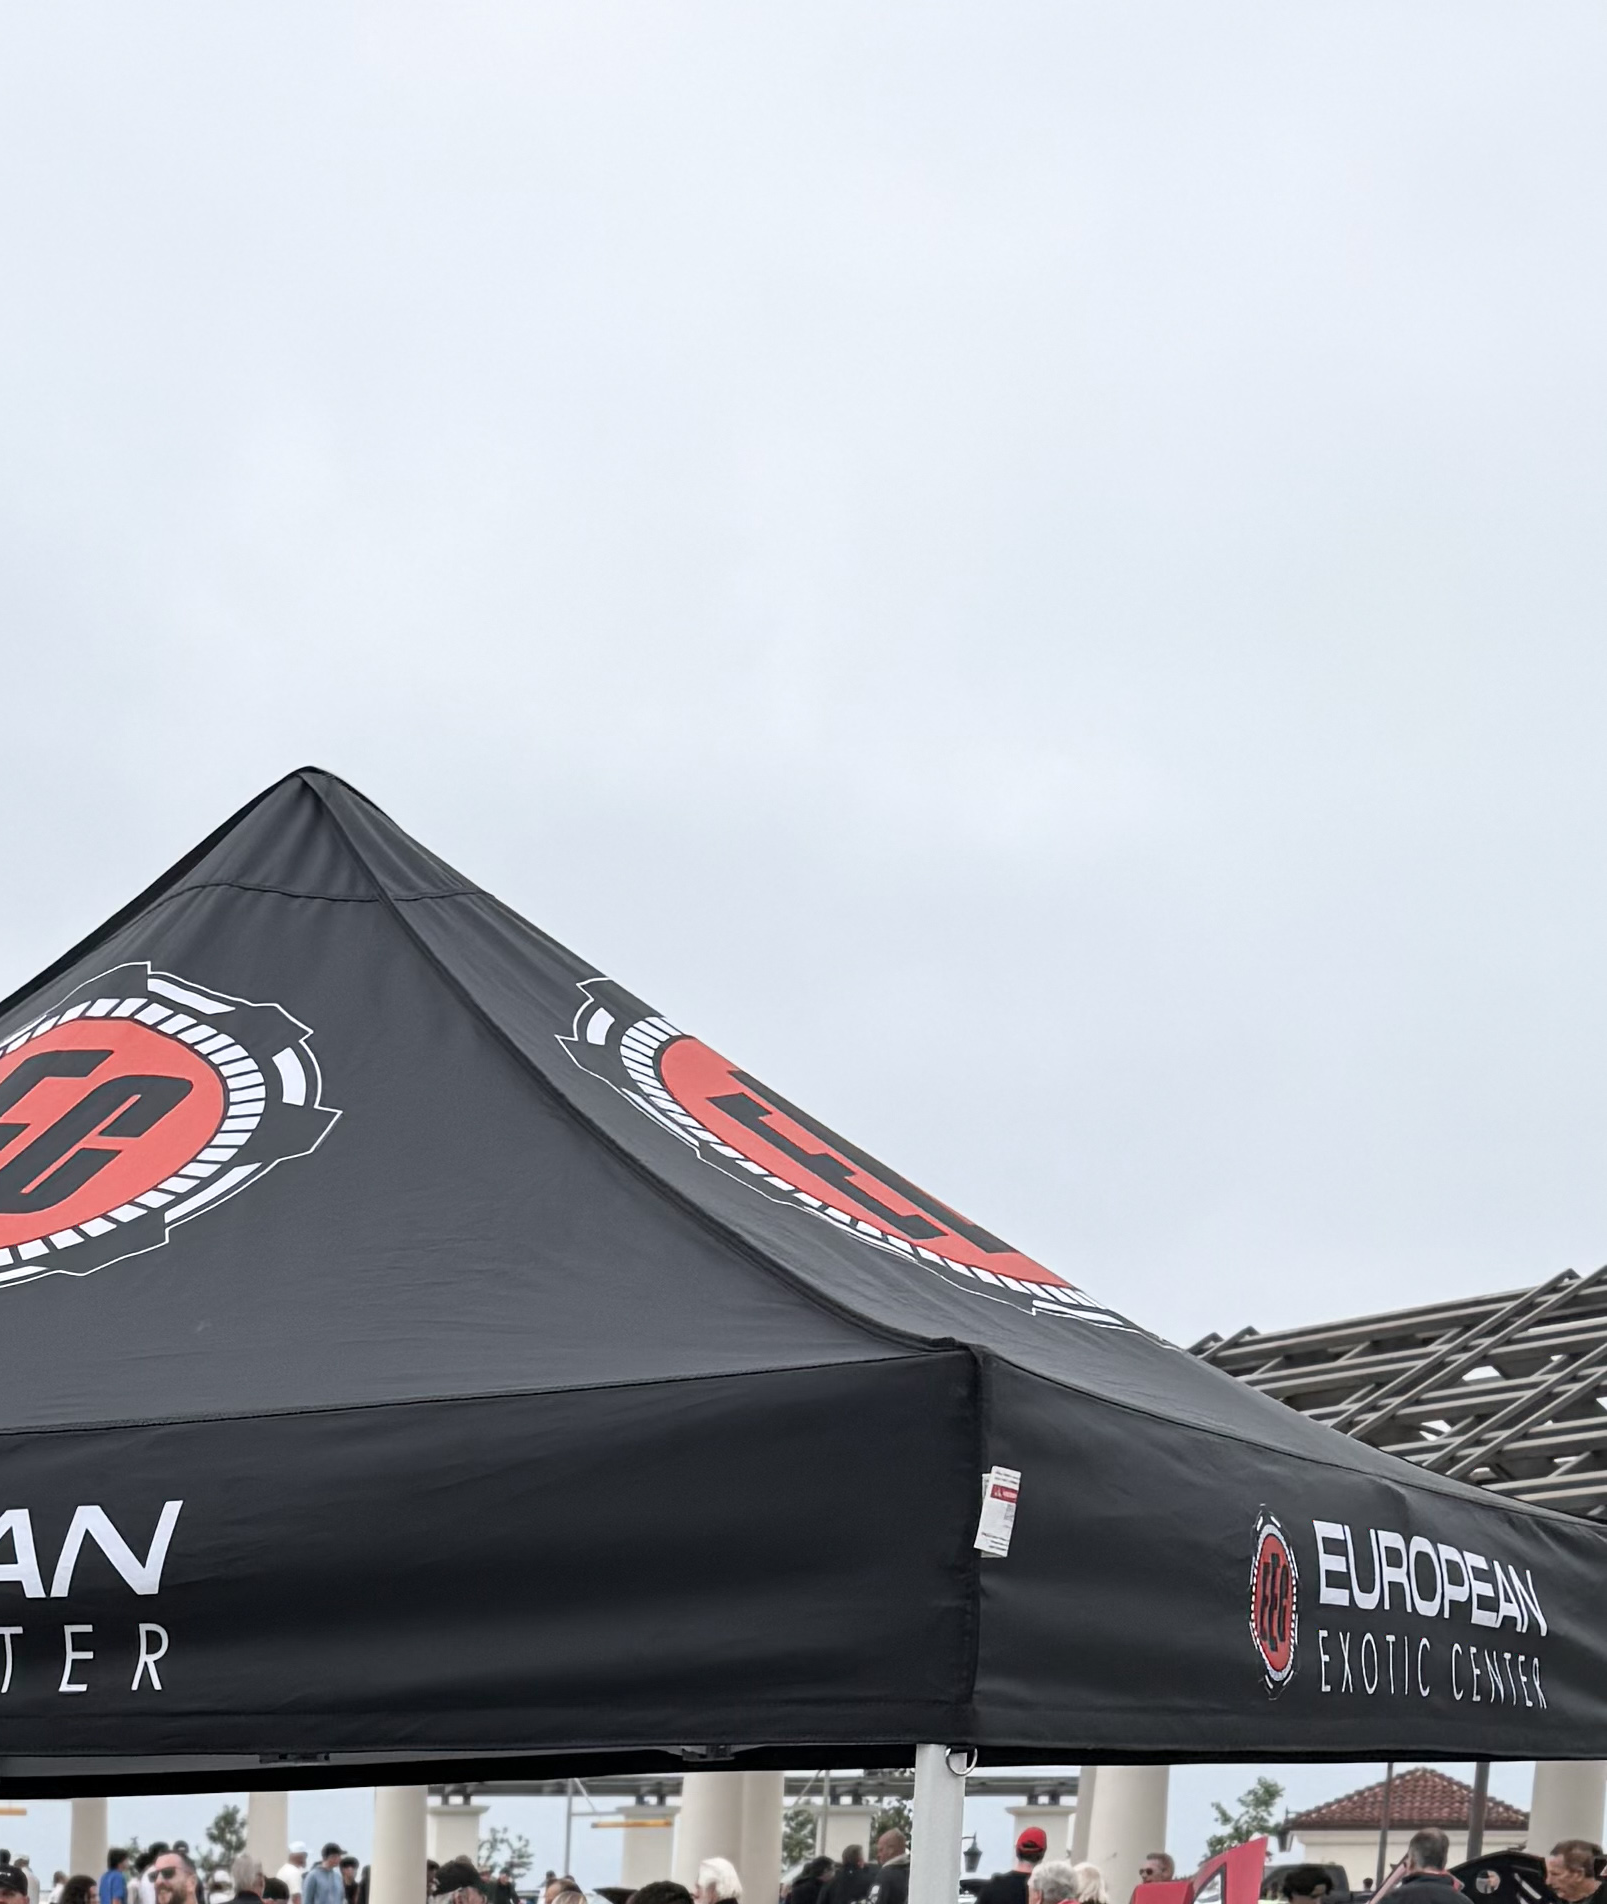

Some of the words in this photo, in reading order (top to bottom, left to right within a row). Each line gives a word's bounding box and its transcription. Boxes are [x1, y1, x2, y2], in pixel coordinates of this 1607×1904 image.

[1312, 1519, 1548, 1637] EUROPEAN
[1318, 1629, 1431, 1697] EXOTIC
[1451, 1642, 1548, 1710] CENTER
